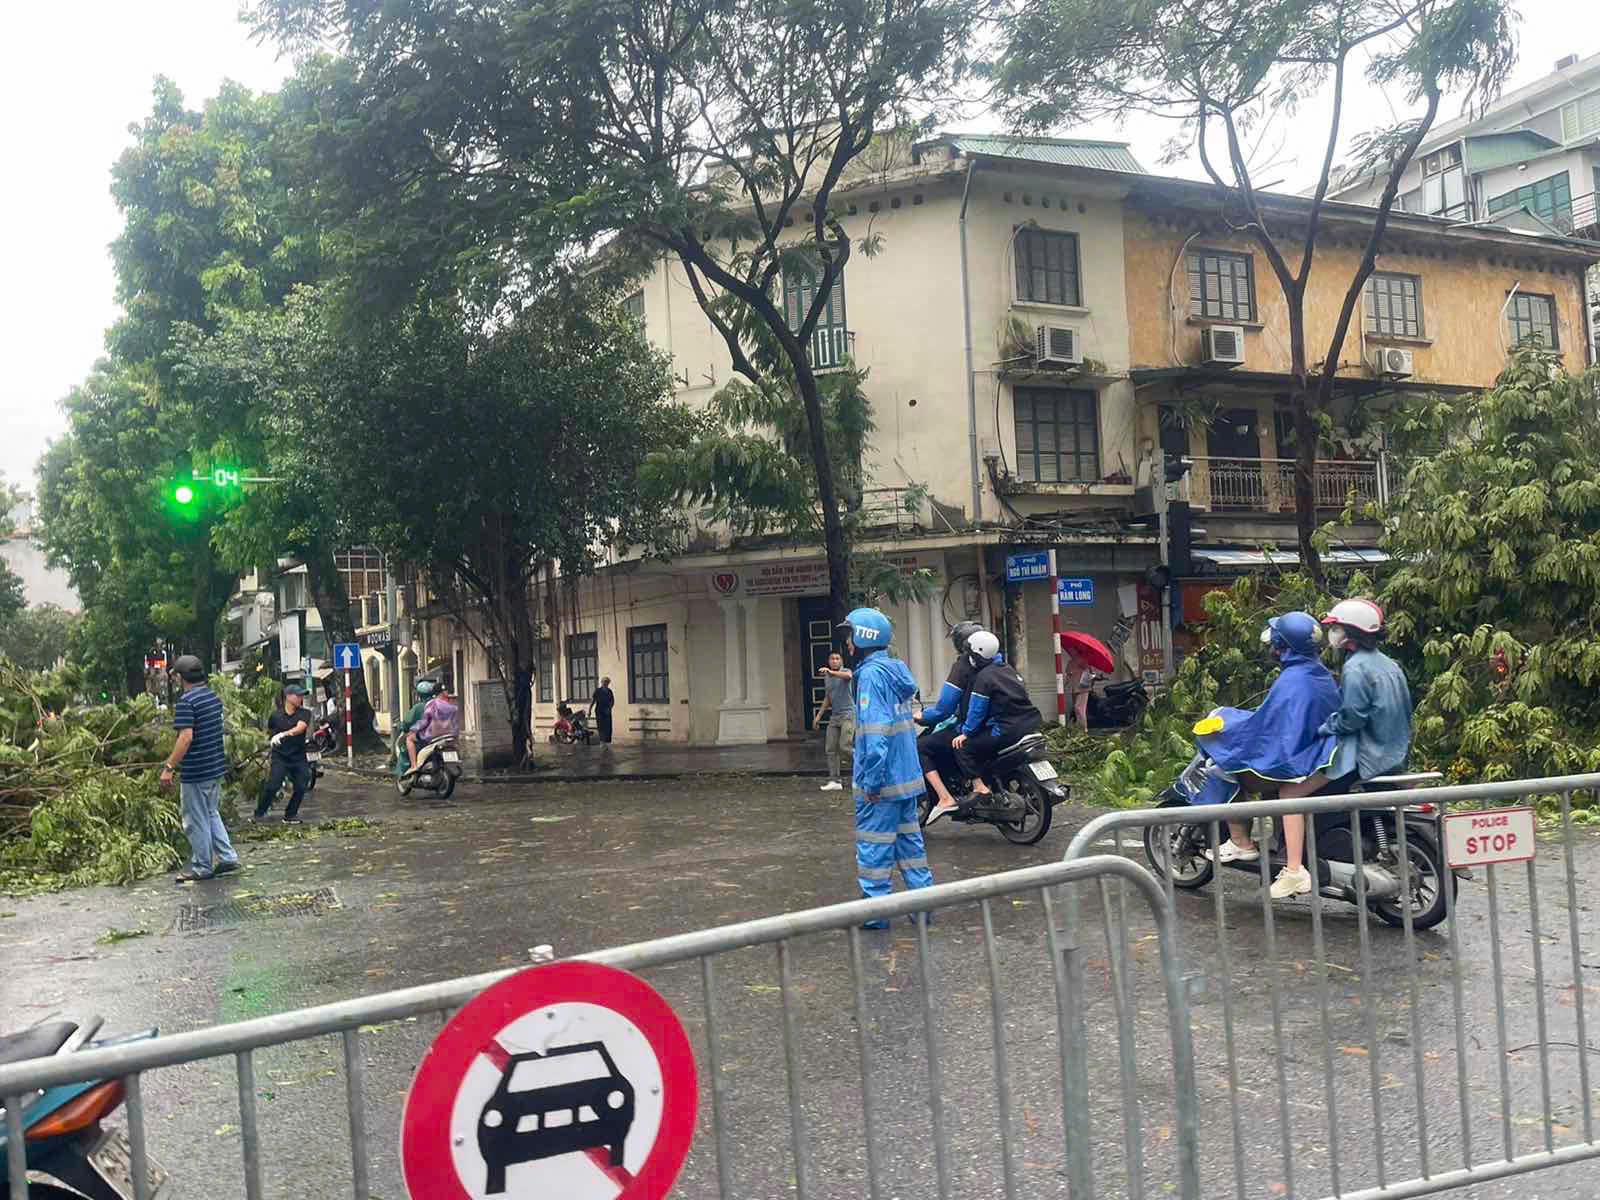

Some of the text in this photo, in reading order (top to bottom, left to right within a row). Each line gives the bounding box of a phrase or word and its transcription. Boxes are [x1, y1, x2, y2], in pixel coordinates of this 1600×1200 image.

[215, 469, 238, 486] 04
[1075, 590, 1091, 601] LONG
[855, 625, 880, 640] TTGT
[1471, 816, 1509, 829] POLICE
[1466, 832, 1517, 855] STOP
